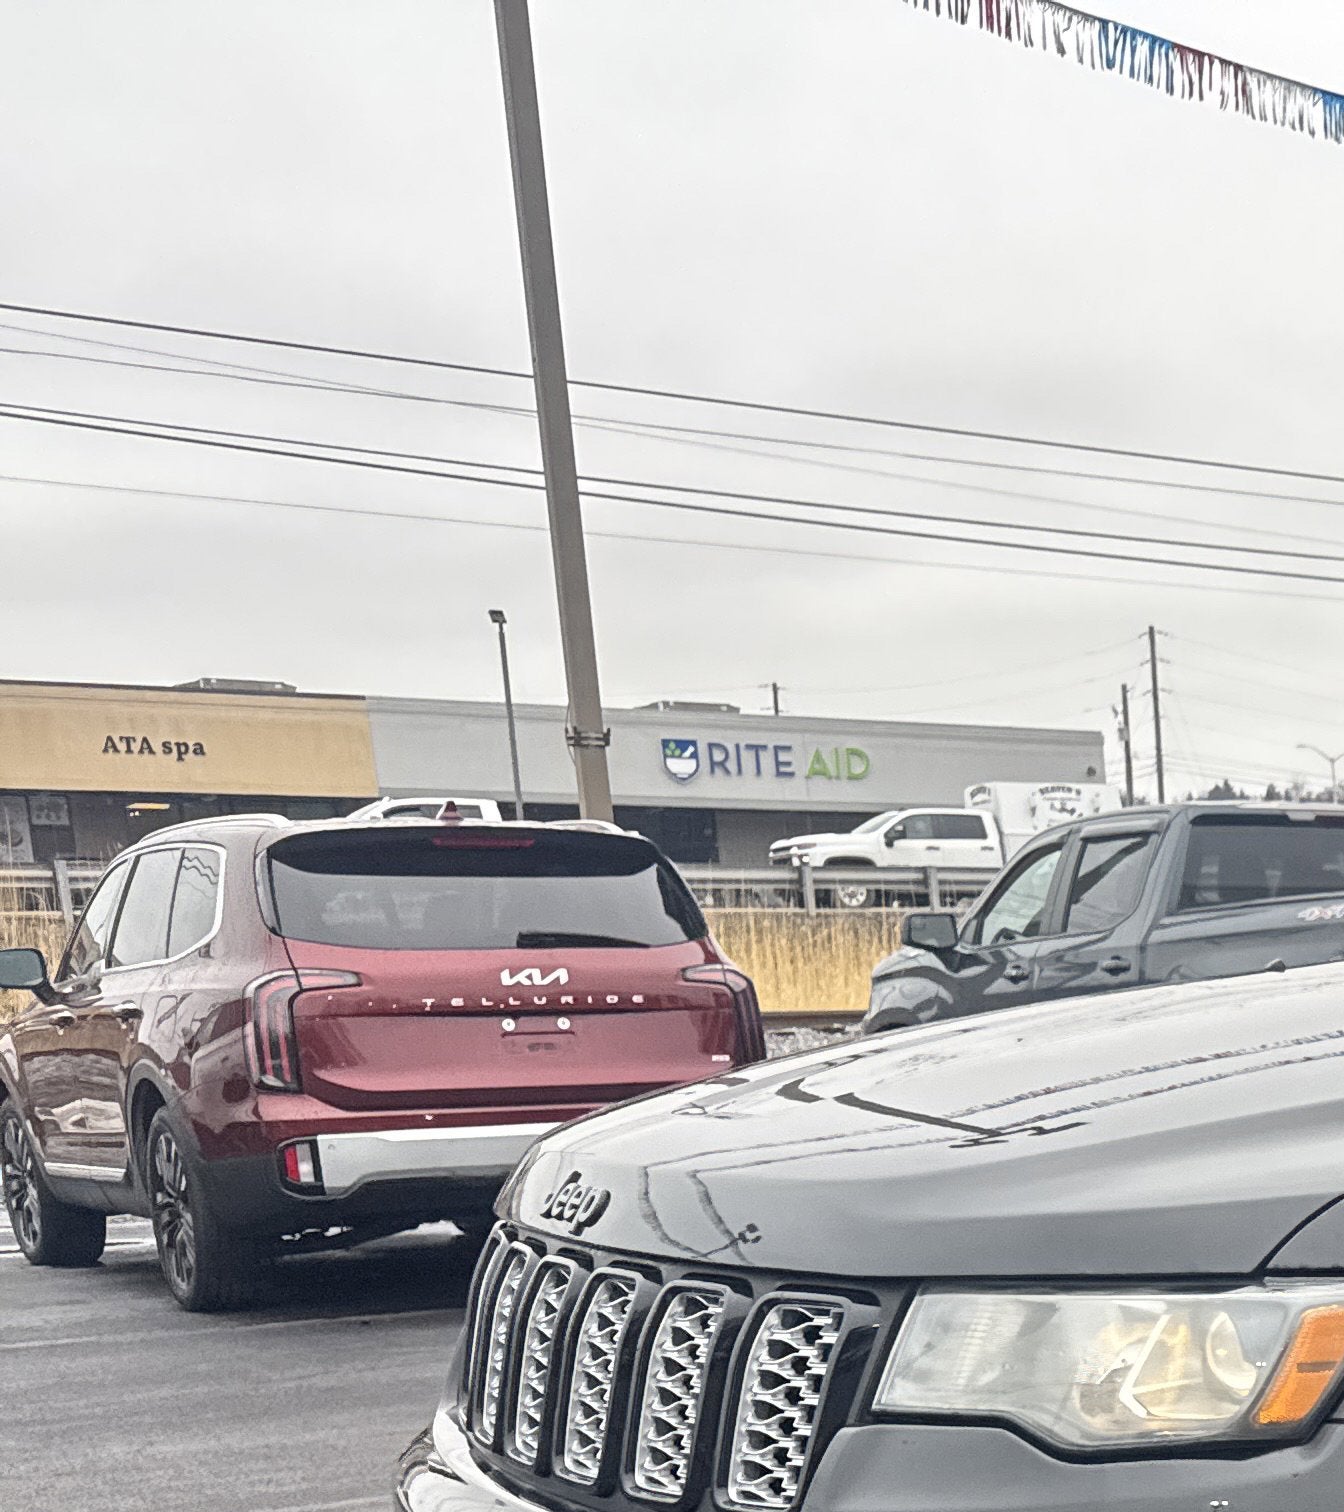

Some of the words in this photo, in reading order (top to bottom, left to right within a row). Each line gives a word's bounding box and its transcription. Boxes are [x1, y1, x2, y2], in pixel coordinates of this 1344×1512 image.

[101, 734, 156, 756] ATA
[161, 740, 206, 762] spa
[706, 741, 796, 778] RITE
[805, 746, 871, 781] AID
[500, 967, 569, 986] KIA
[421, 993, 646, 1008] TELLURIDE
[540, 1170, 612, 1237] Jeep
